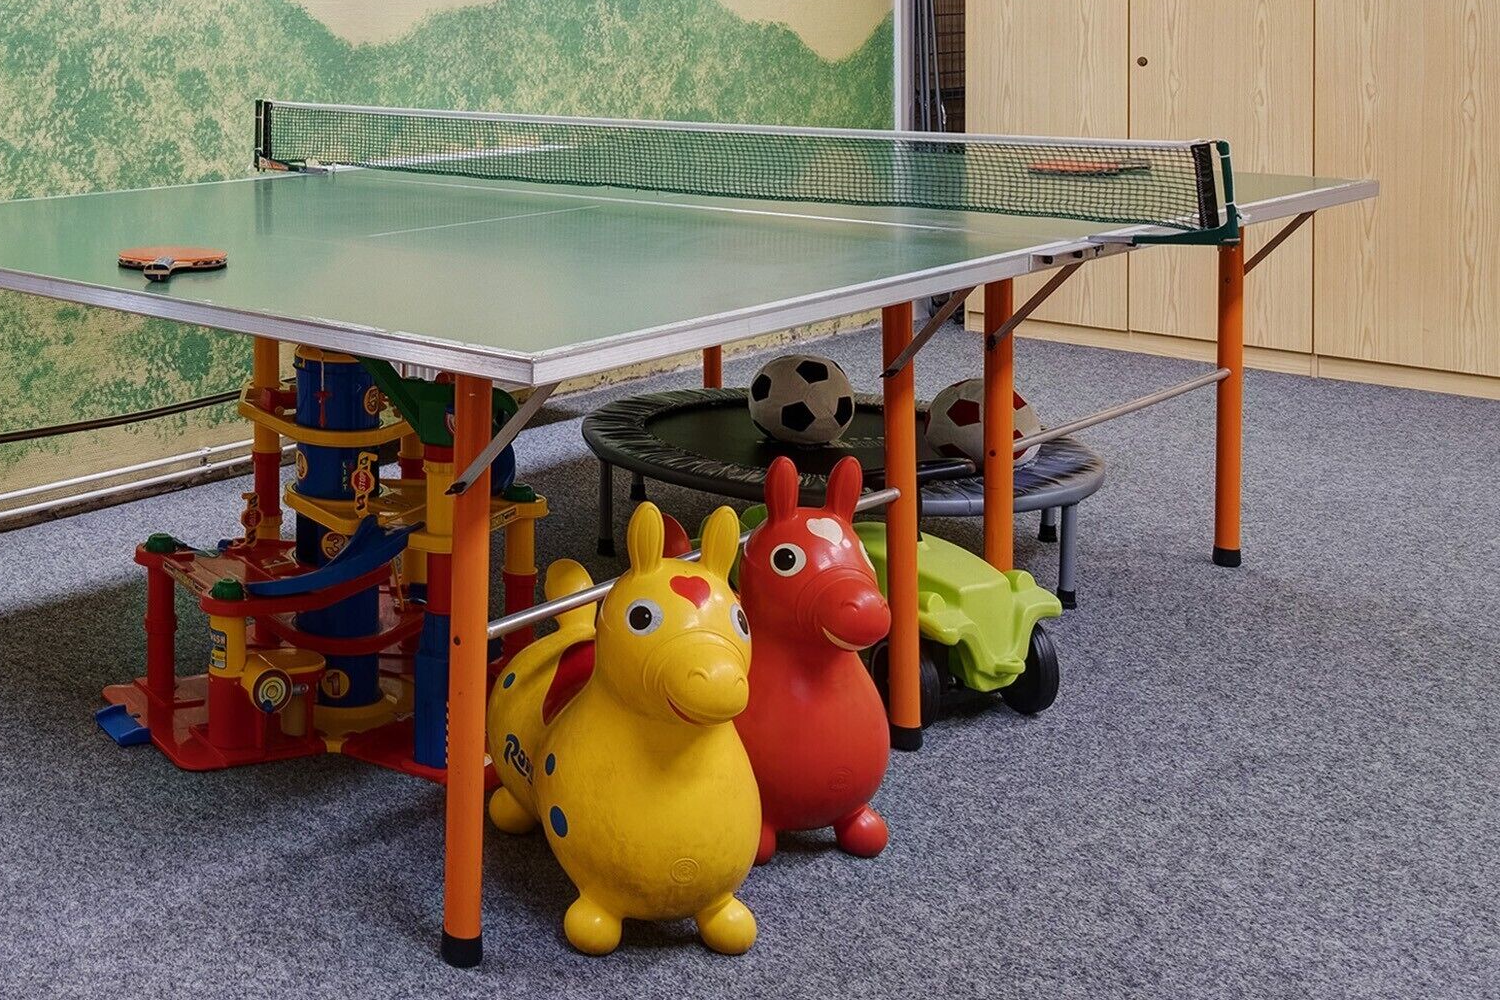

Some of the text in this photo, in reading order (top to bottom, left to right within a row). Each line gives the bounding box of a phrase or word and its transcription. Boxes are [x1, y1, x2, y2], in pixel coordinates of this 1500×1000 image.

[358, 471, 367, 491] STOP
[325, 533, 346, 557] 3
[326, 672, 341, 696] 1
